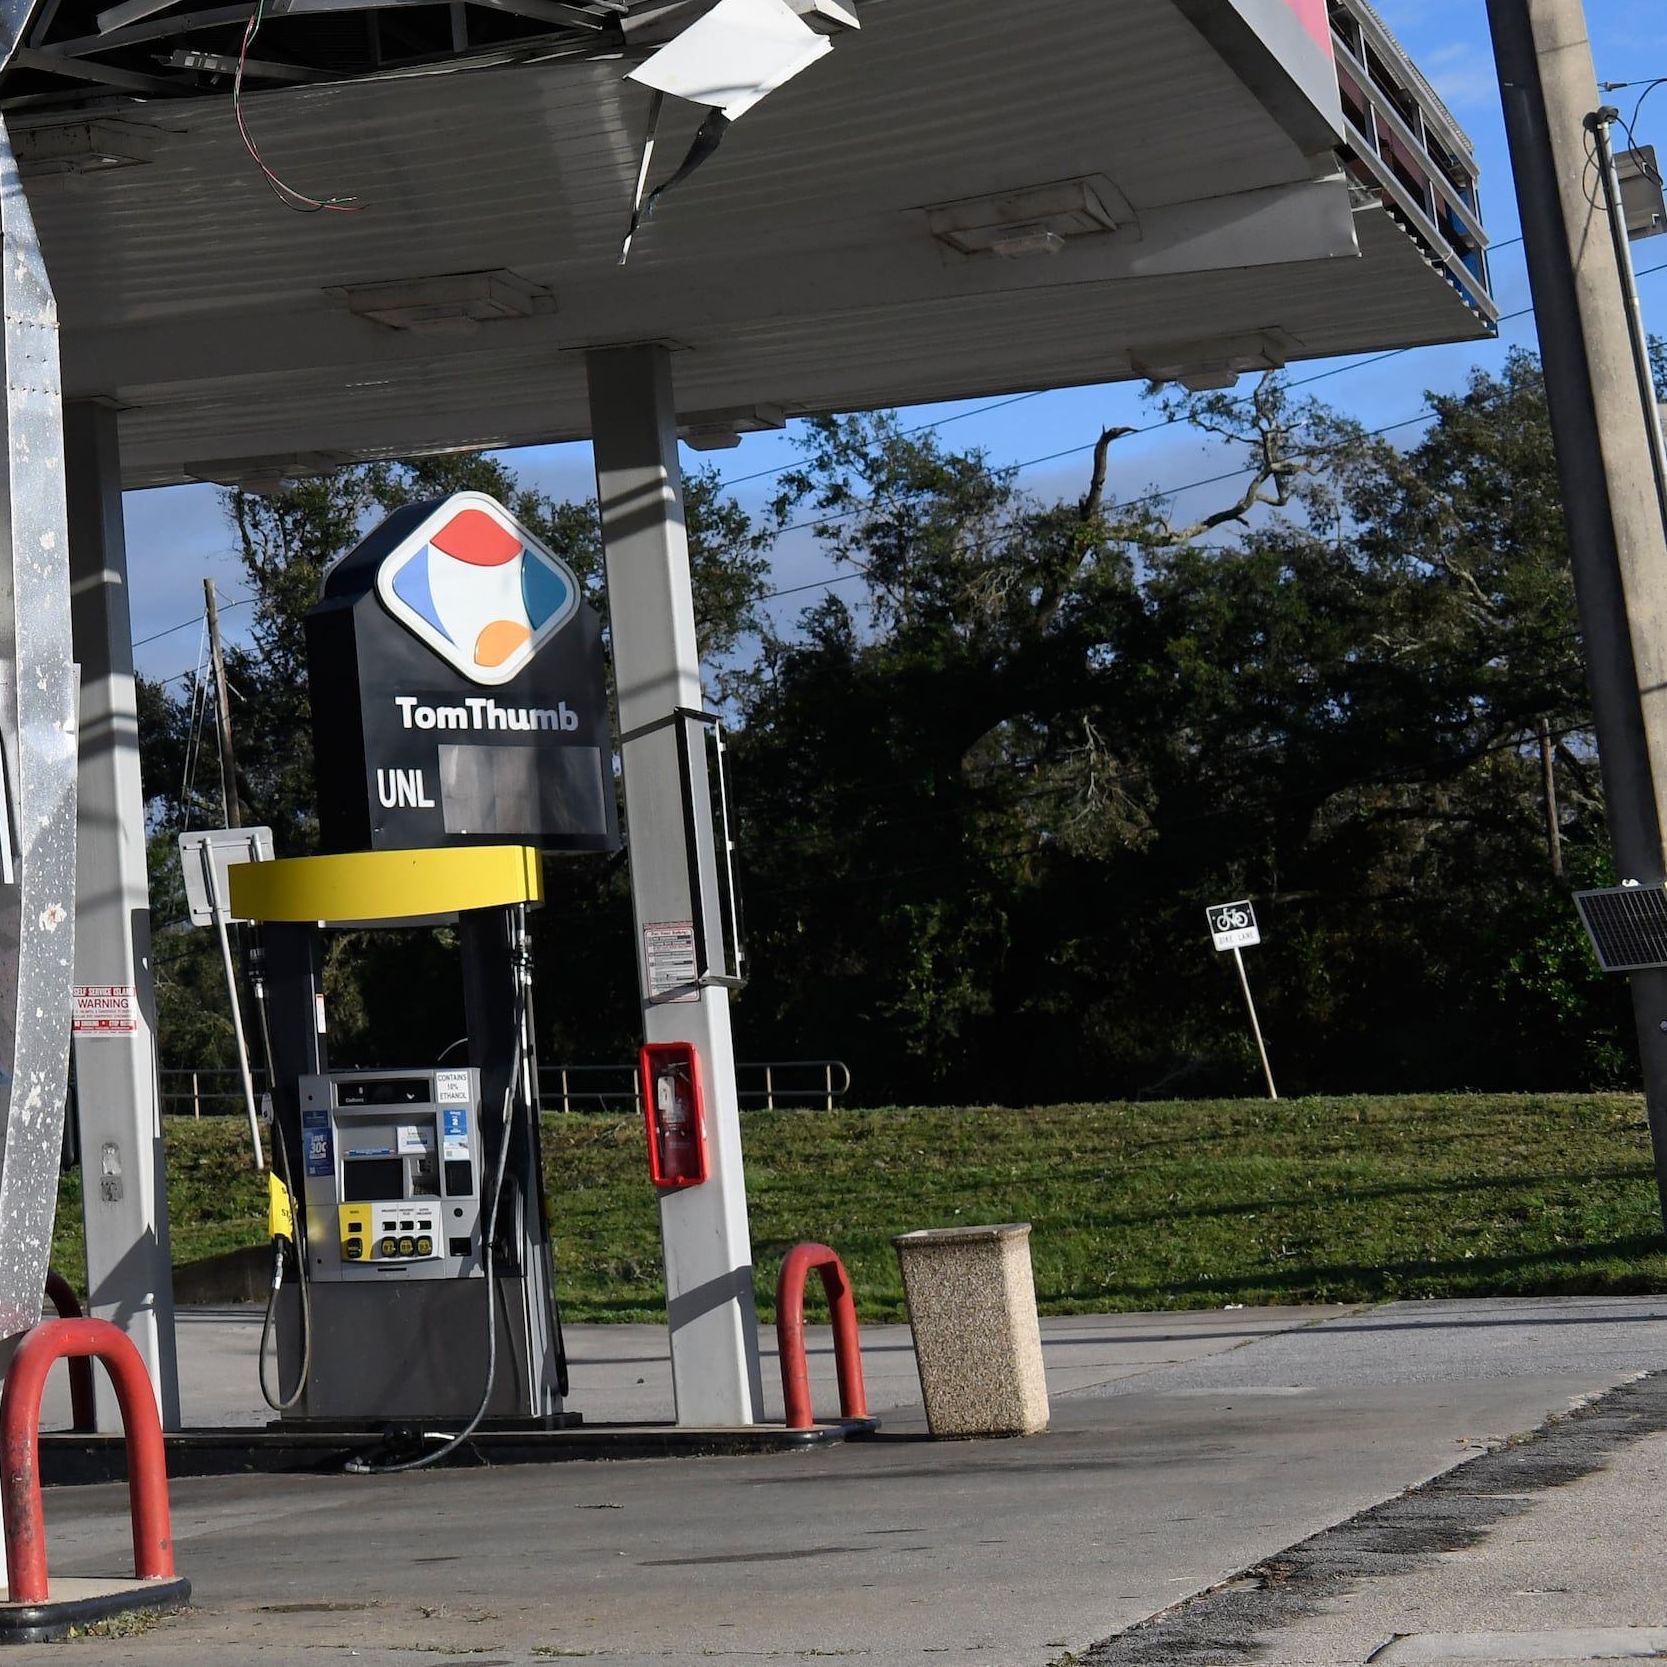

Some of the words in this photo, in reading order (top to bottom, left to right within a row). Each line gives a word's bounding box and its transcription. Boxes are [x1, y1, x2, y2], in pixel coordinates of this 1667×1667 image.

[395, 696, 579, 732] TomThumb
[377, 768, 435, 808] UNL
[77, 998, 129, 1009] WARNING
[438, 1074, 467, 1082] CONTAINS
[439, 1093, 467, 1101] ETHANOL
